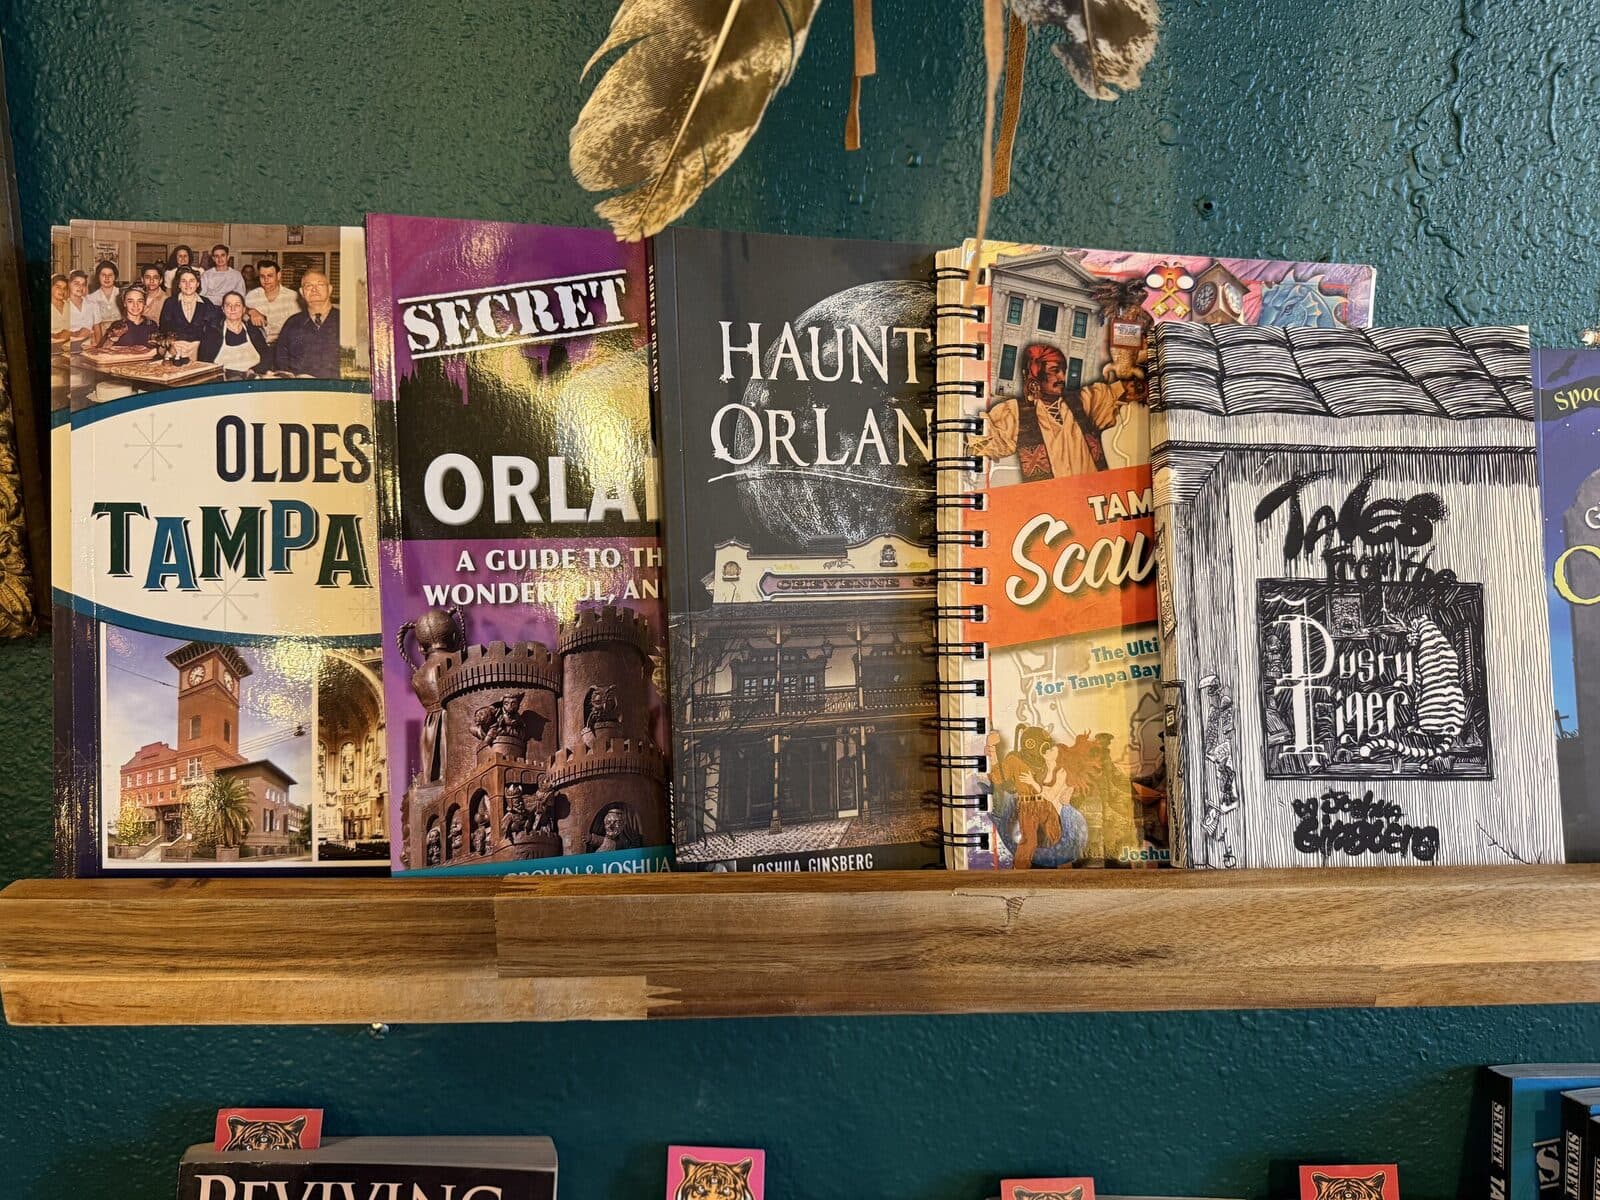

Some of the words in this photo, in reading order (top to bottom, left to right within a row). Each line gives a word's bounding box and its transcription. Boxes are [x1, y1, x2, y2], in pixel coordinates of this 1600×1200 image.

[402, 277, 626, 351] SECRET
[652, 333, 660, 393] ORLANDO
[718, 320, 932, 384] HAUNT
[216, 414, 373, 483] OLDES
[710, 403, 937, 467] ORLAN
[424, 453, 659, 525] ORLA
[1088, 489, 1154, 522] TAM
[91, 500, 374, 591] TAMPA
[456, 550, 476, 571] A
[485, 549, 576, 571] GUIDE
[581, 547, 621, 568] TO
[629, 547, 662, 567] TH
[423, 579, 615, 605] WONDERUL,
[623, 579, 659, 599] AN
[1035, 679, 1064, 696] for
[1068, 668, 1127, 690] Tampa
[1130, 663, 1161, 681] Bay
[1091, 646, 1124, 662] The
[1126, 637, 1160, 656] Ulti
[808, 853, 874, 872] GINSBERG
[1119, 846, 1170, 862] Joshu
[1492, 1101, 1504, 1169] SECRET
